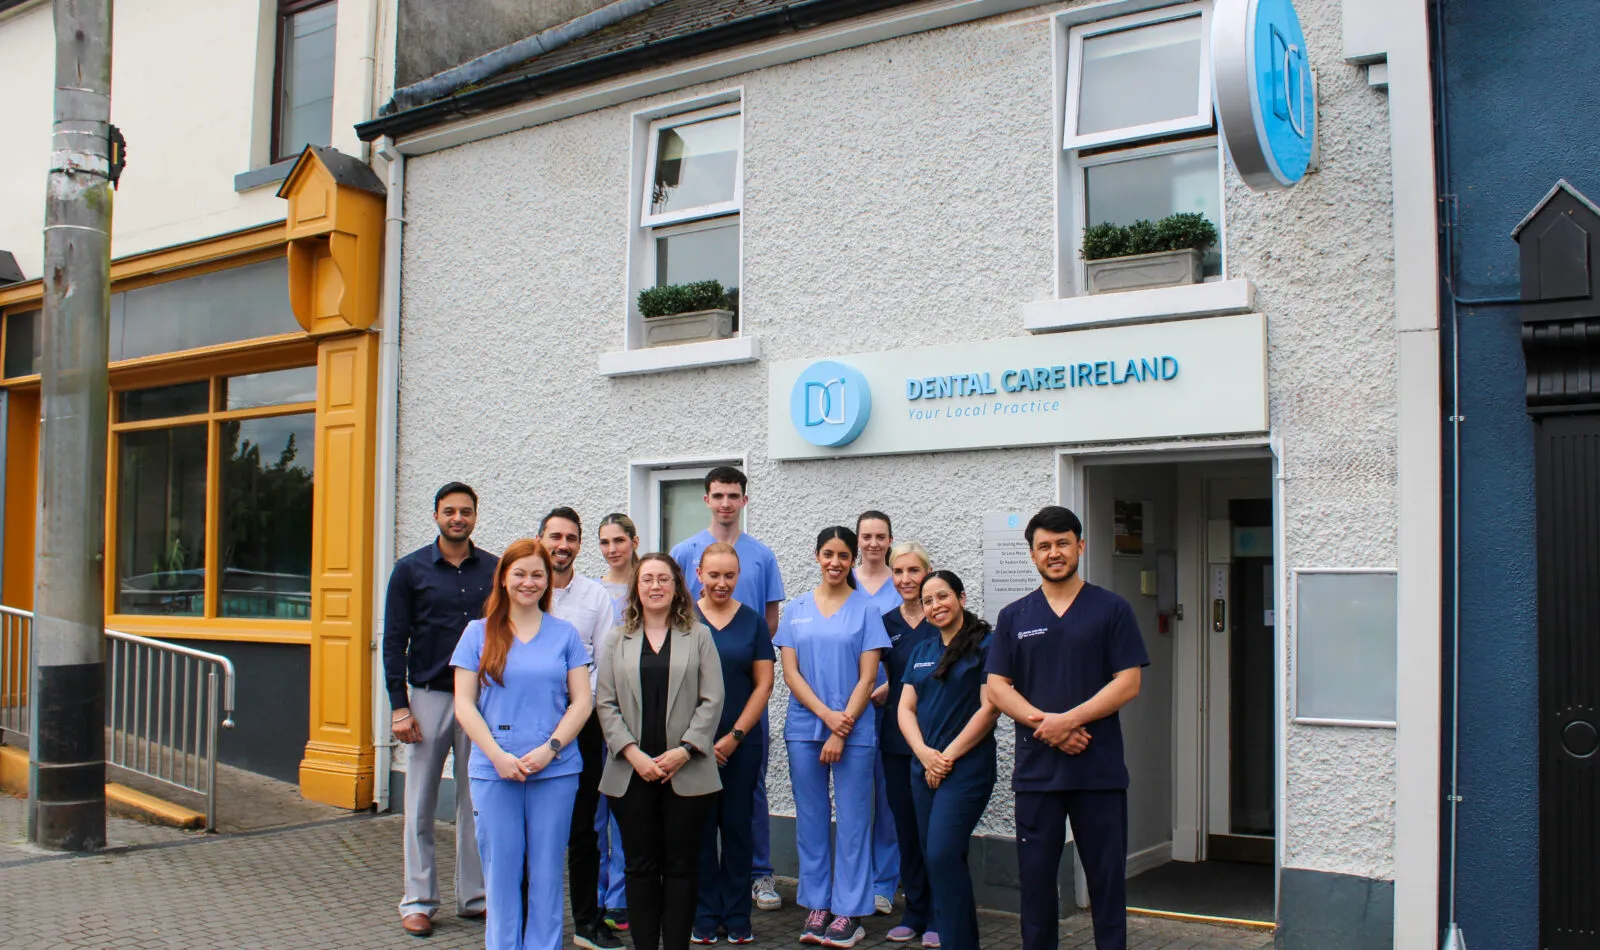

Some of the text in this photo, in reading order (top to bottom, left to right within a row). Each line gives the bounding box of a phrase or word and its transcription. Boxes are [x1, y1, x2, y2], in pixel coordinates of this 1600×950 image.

[905, 355, 1179, 401] DENTAL CARE IRELAND
[908, 399, 1061, 420] Your Local Practice
